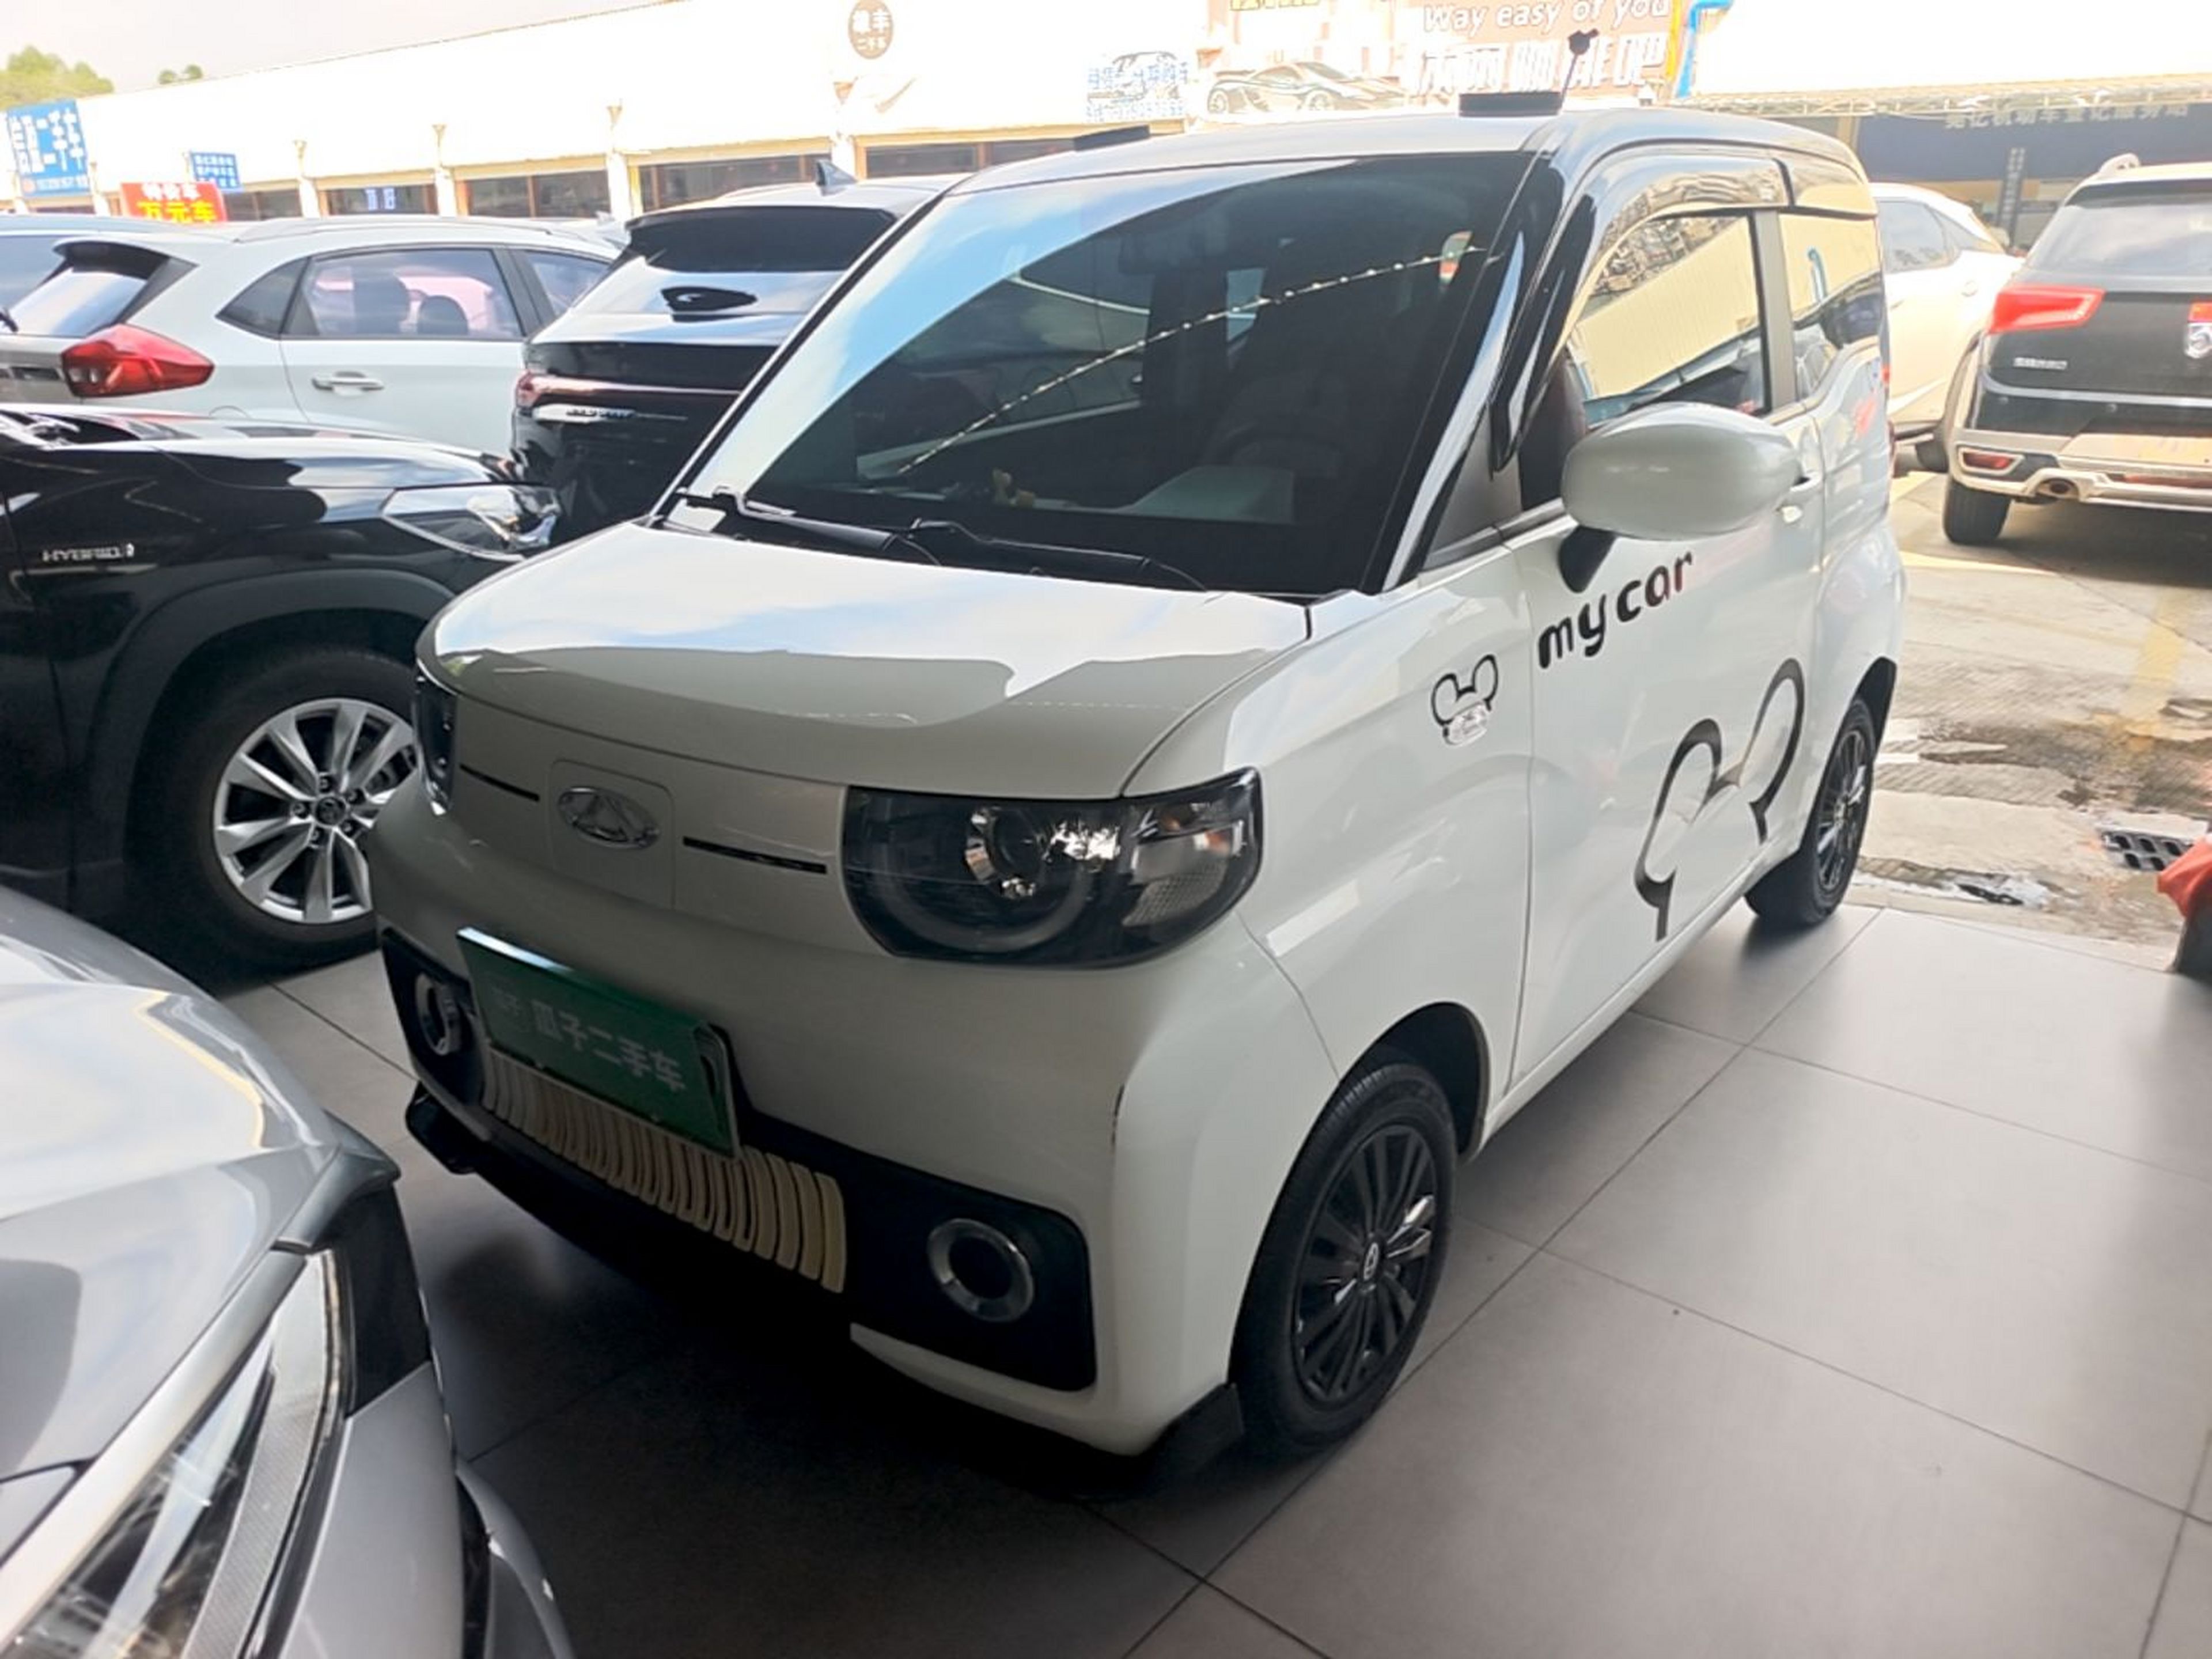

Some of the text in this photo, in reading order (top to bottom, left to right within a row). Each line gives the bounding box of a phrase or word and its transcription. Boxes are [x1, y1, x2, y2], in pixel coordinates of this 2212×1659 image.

[1423, 0, 1669, 37] Way easy of you
[137, 200, 217, 223] 万元车
[42, 547, 120, 562] HYBRID
[1539, 551, 1694, 669] my car
